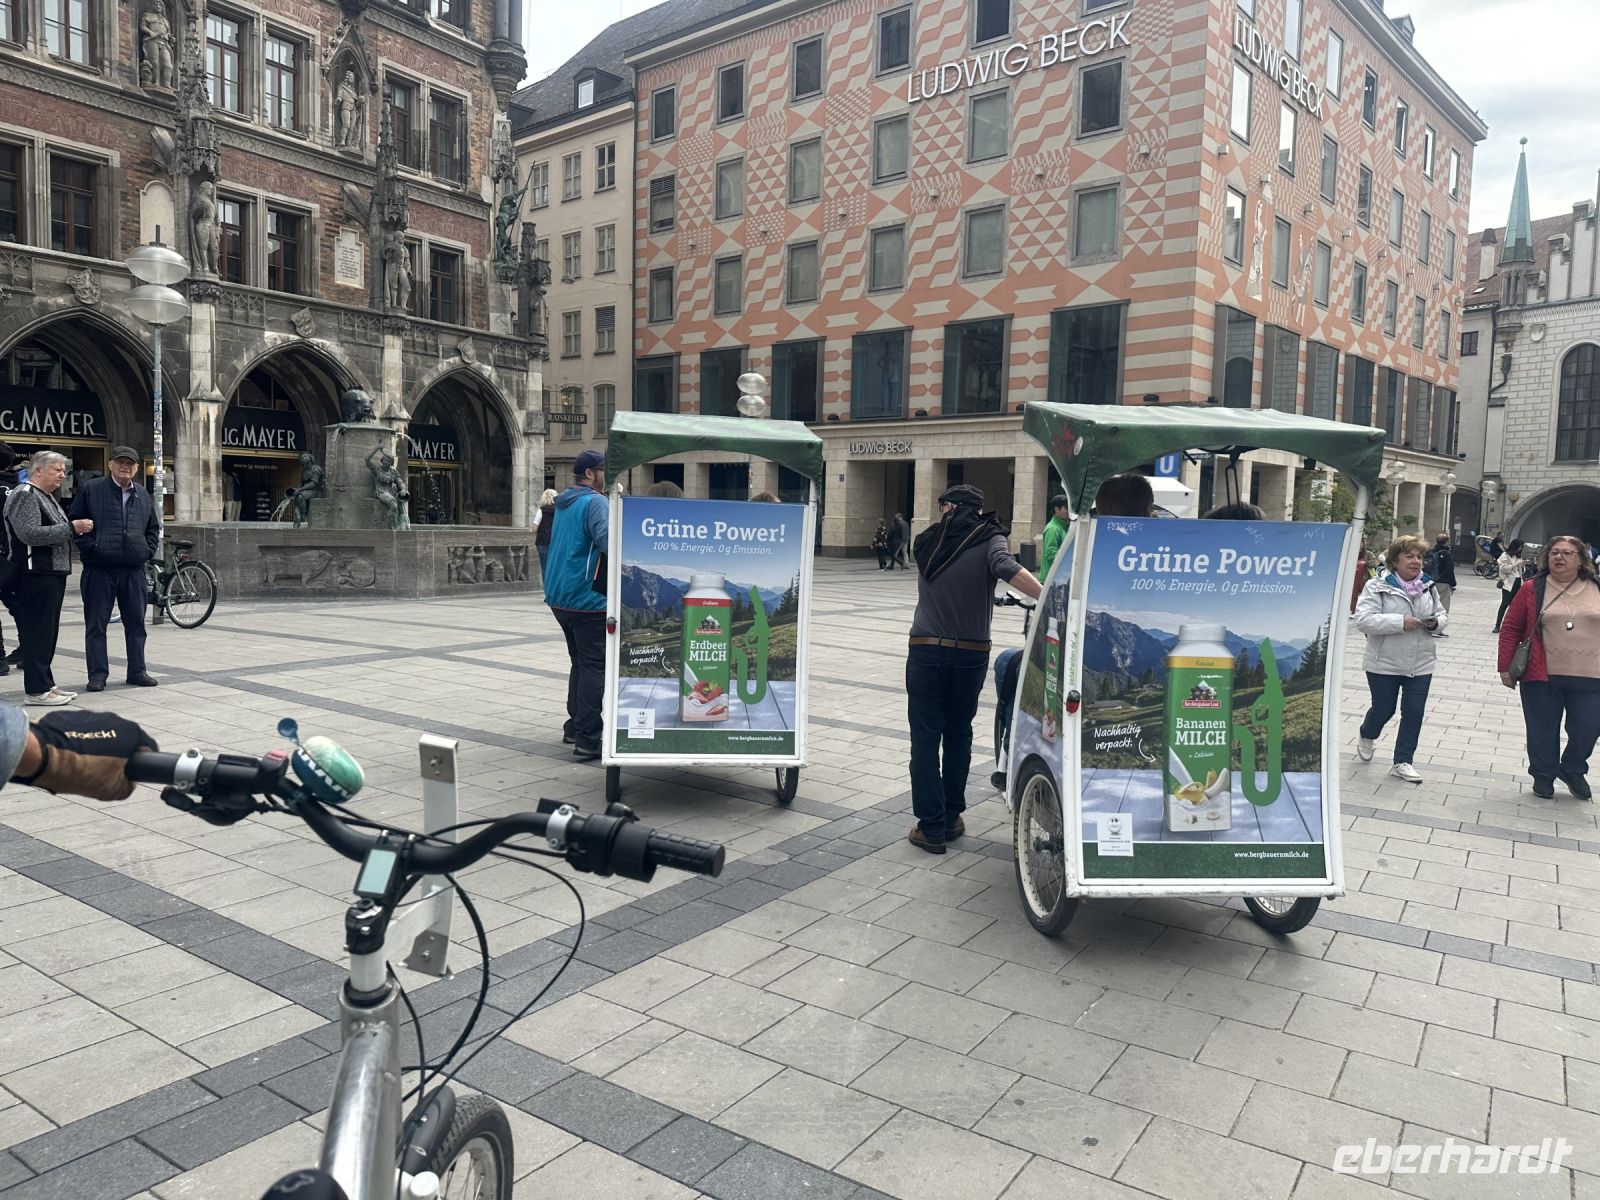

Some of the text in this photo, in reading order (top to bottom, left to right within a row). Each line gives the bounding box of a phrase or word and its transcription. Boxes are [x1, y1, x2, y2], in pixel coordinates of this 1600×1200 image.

[907, 11, 1132, 103] LUDWIG BECK
[1235, 11, 1324, 120] LUDWIG BECK
[848, 440, 911, 454] LUDWIG BECK
[1160, 455, 1174, 474] U
[641, 517, 785, 543] Grüne Power!
[680, 543, 716, 554] Energie.
[1117, 545, 1317, 577] Grüne Power!
[1168, 579, 1217, 595] Energie.
[1241, 580, 1296, 594] Emission.
[690, 640, 727, 649] Erdbeer
[689, 650, 727, 661] MILCH
[1094, 723, 1142, 738] Nachhaltig
[1175, 717, 1226, 729] Bananen
[1095, 737, 1133, 752] verpackt.
[1174, 730, 1226, 746] MILCH
[1234, 851, 1309, 859] www.bergbauernmilch.de
